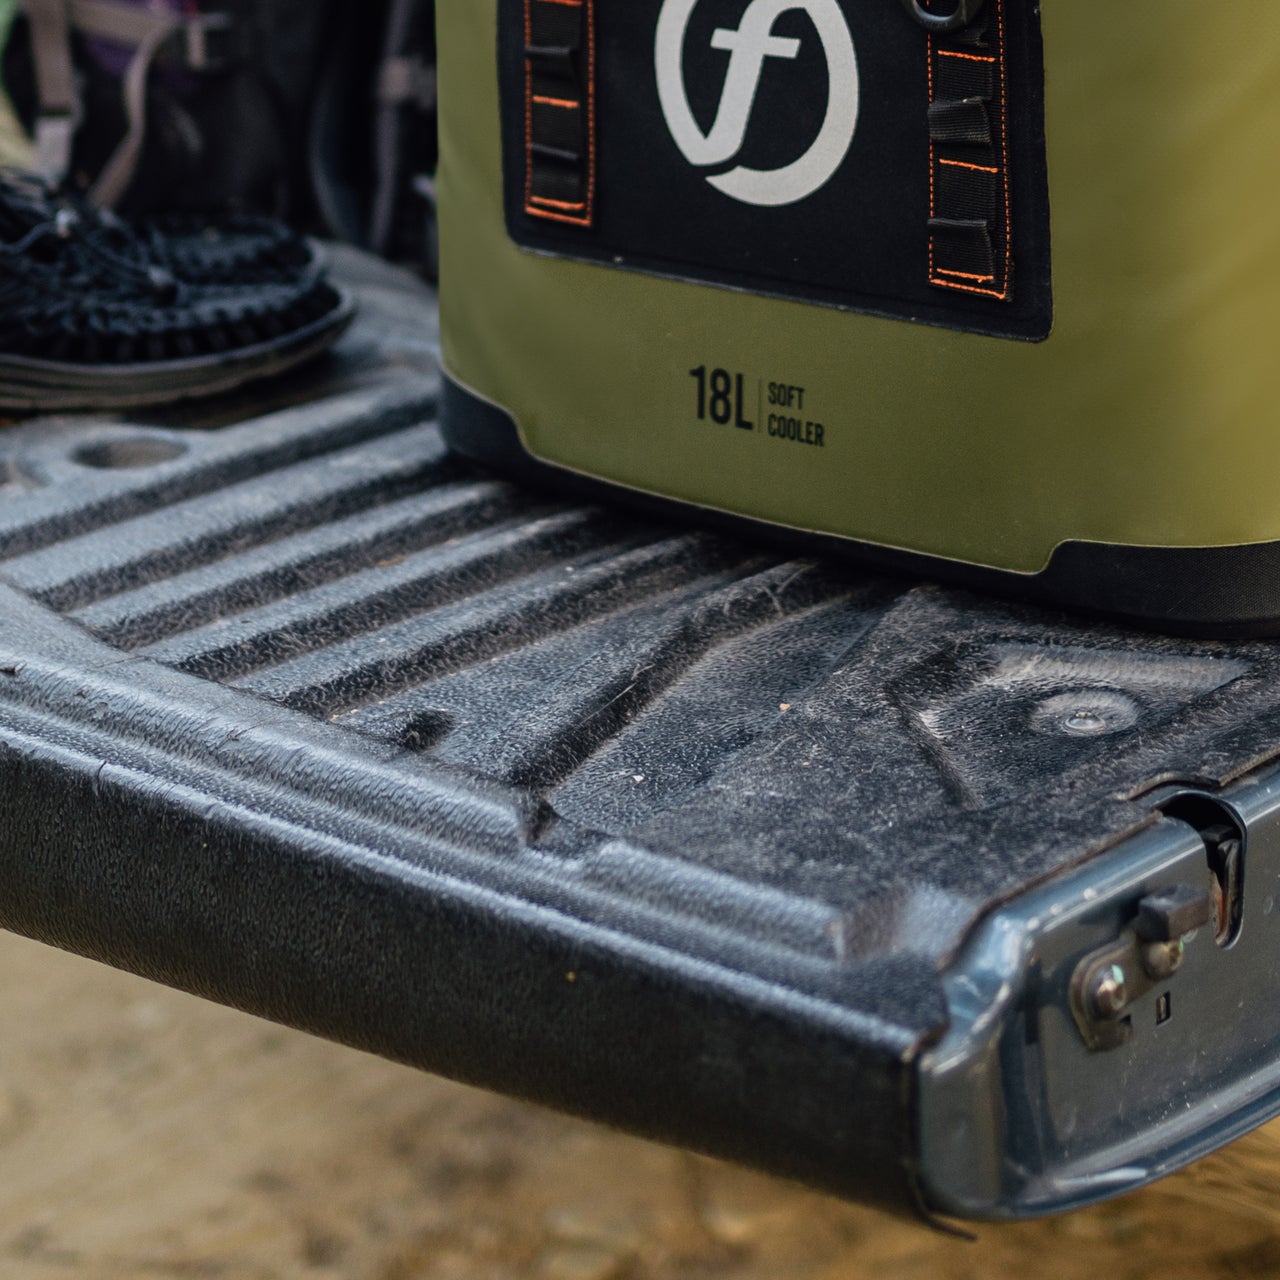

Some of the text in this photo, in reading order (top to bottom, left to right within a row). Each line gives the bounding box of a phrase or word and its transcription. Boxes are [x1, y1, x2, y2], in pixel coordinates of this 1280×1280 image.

[688, 364, 754, 431] 18L
[767, 381, 806, 410] SOFT
[767, 413, 825, 448] COOLER
